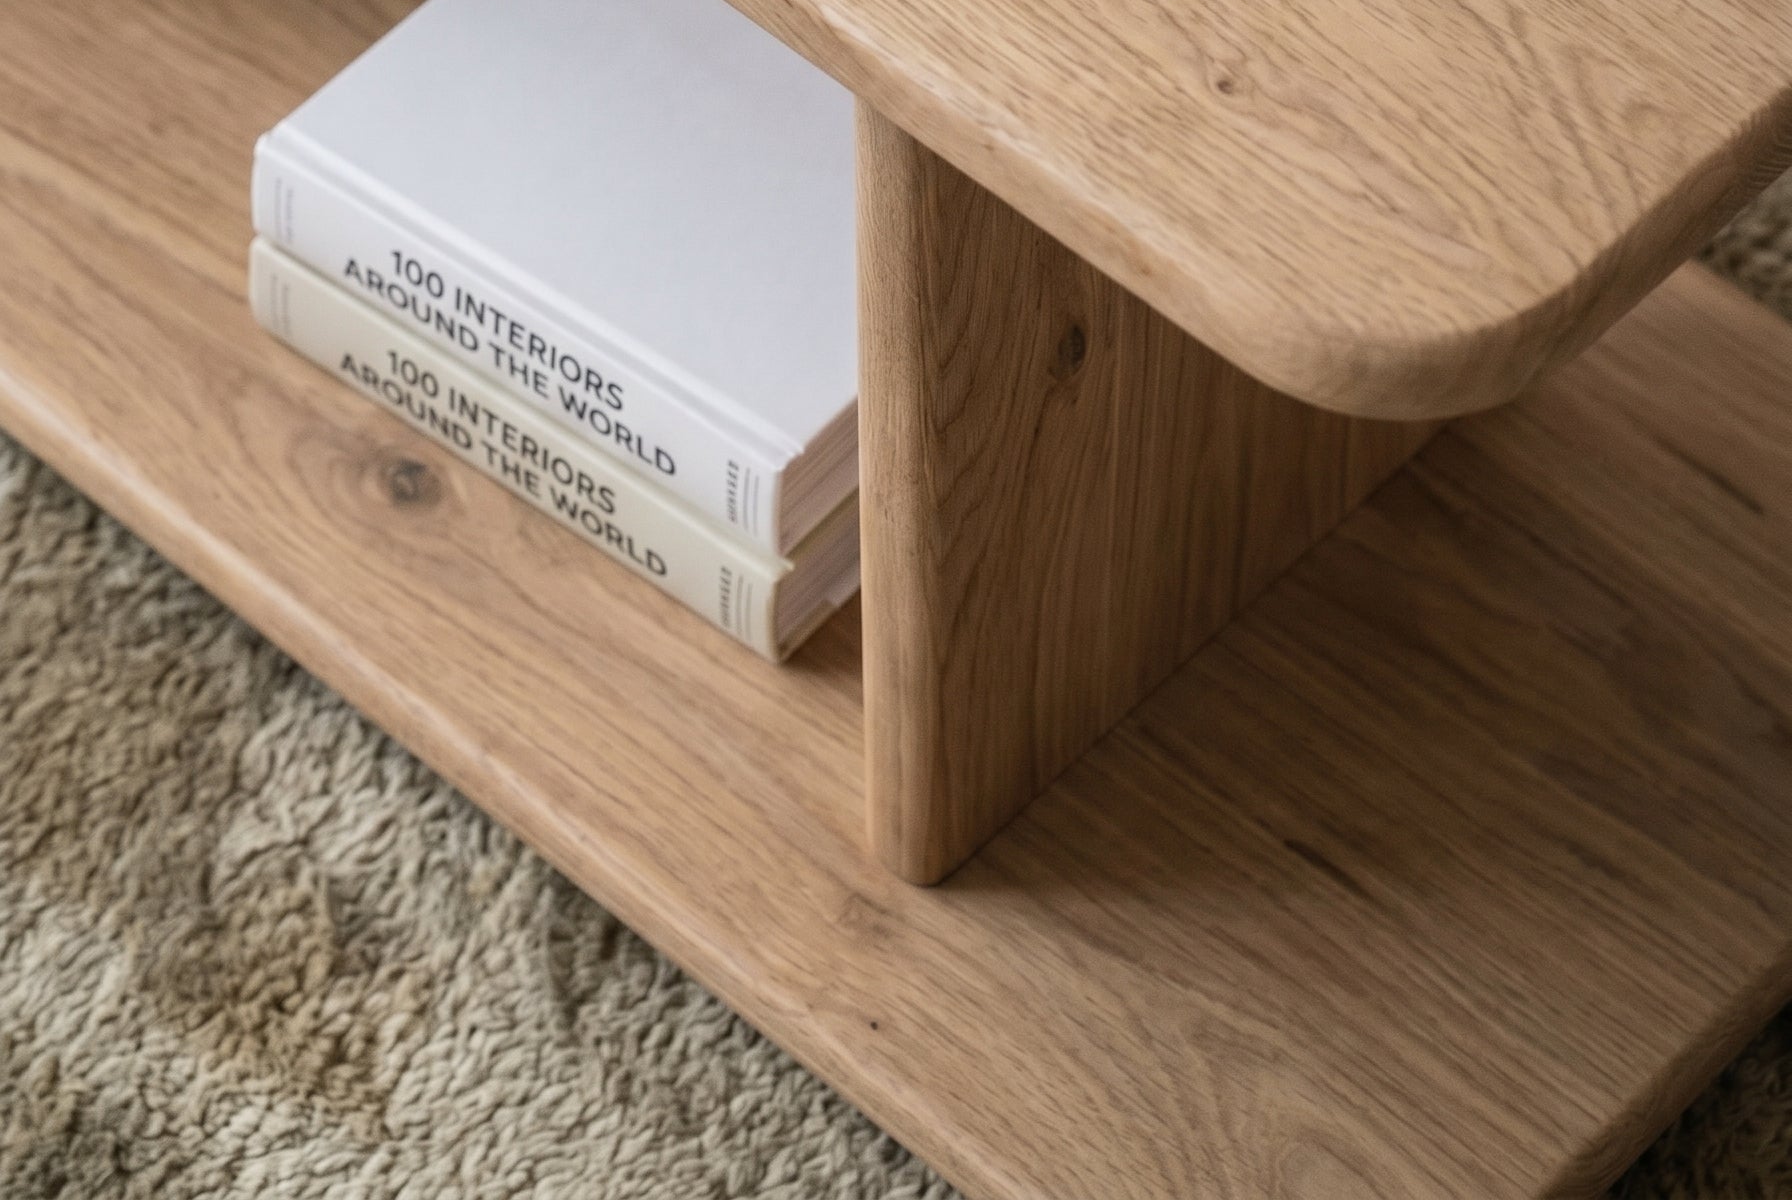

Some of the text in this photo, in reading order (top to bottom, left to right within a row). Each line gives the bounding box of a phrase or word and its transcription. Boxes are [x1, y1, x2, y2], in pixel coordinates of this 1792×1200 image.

[343, 259, 677, 476] AROUND THE WORLD
[391, 250, 624, 412] 100 INTERIORS
[340, 354, 472, 451] AROUND
[481, 441, 541, 498] THE
[550, 486, 667, 576] WORLD
[387, 350, 616, 515] 100 INTERIORS
